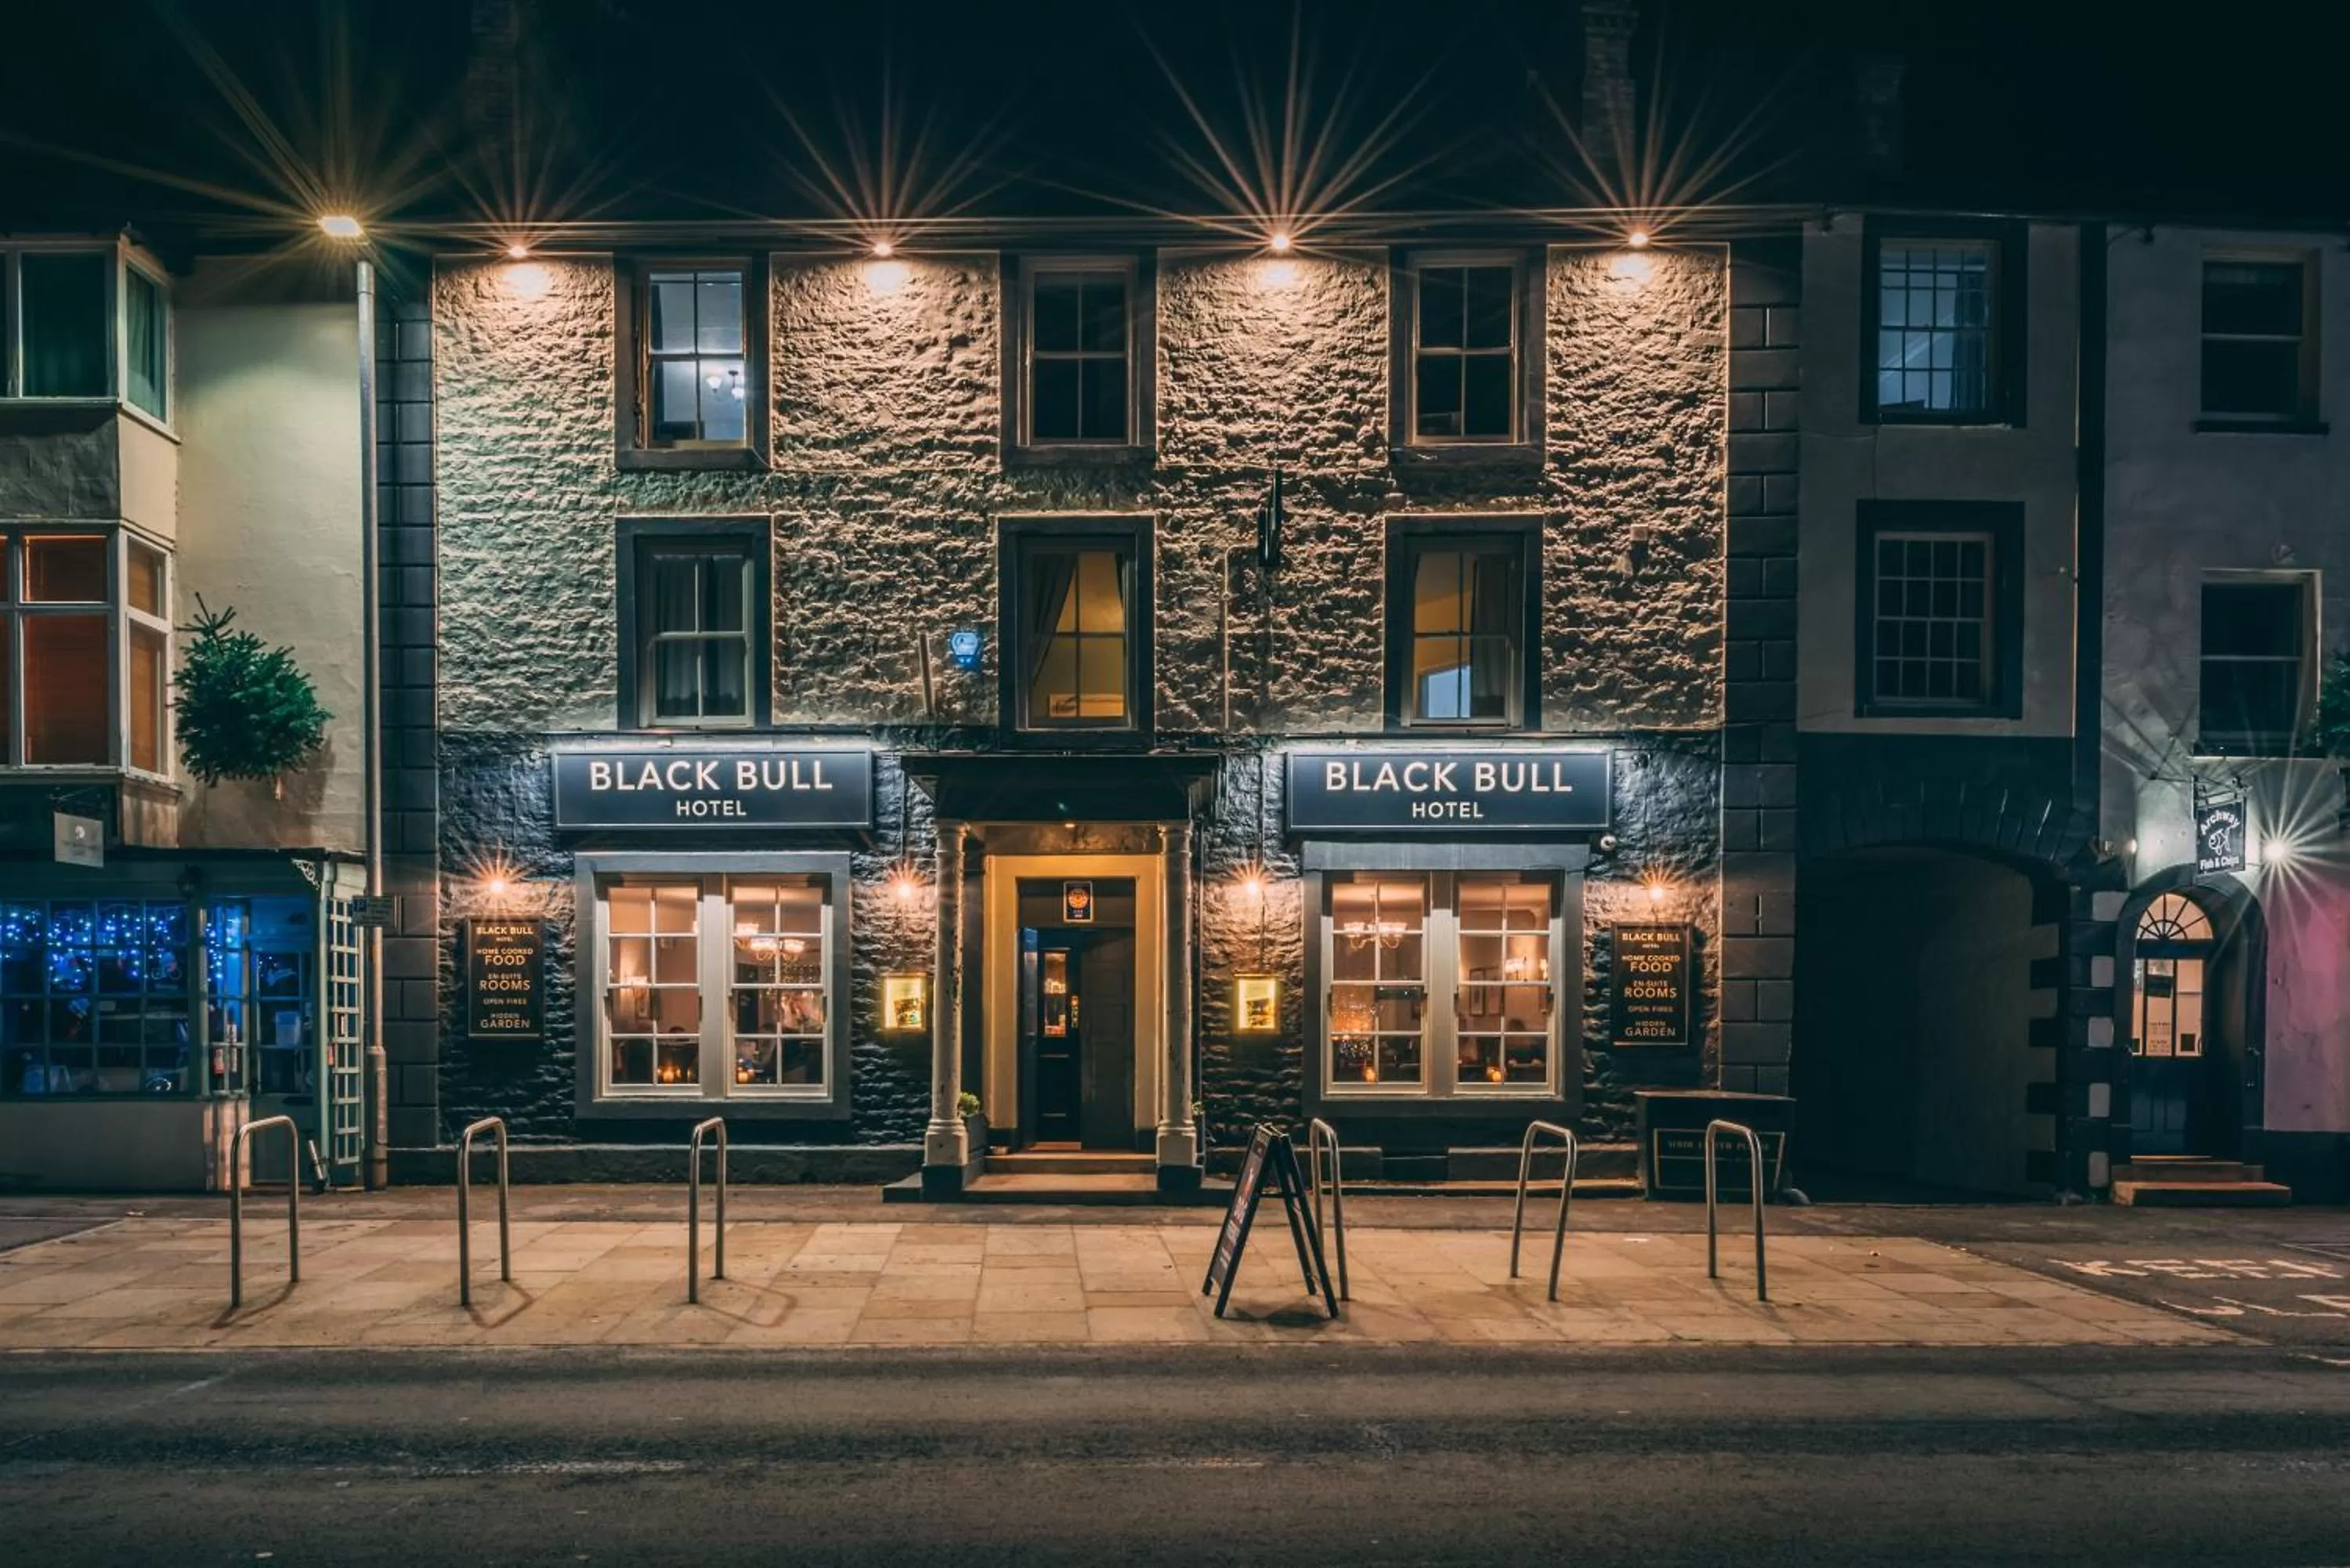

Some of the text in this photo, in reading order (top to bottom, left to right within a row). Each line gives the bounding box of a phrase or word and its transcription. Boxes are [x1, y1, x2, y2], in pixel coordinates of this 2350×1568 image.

[589, 761, 833, 791] BLACK BULL
[1325, 761, 1572, 792] BLACK BULL
[676, 800, 747, 816] HOTEL
[1412, 802, 1484, 818] HOTEL
[2200, 810, 2241, 836] Archway
[2200, 858, 2214, 870] Fish
[2221, 856, 2240, 868] Chips
[1622, 933, 1680, 941] BLACK BULL
[485, 955, 526, 966] FOOD
[1630, 962, 1673, 973] FOOD
[479, 980, 531, 991] ROOMS
[1624, 988, 1677, 999] ROOMS
[480, 1019, 530, 1028] GARDEN
[1625, 1027, 1676, 1037] GARDEN
